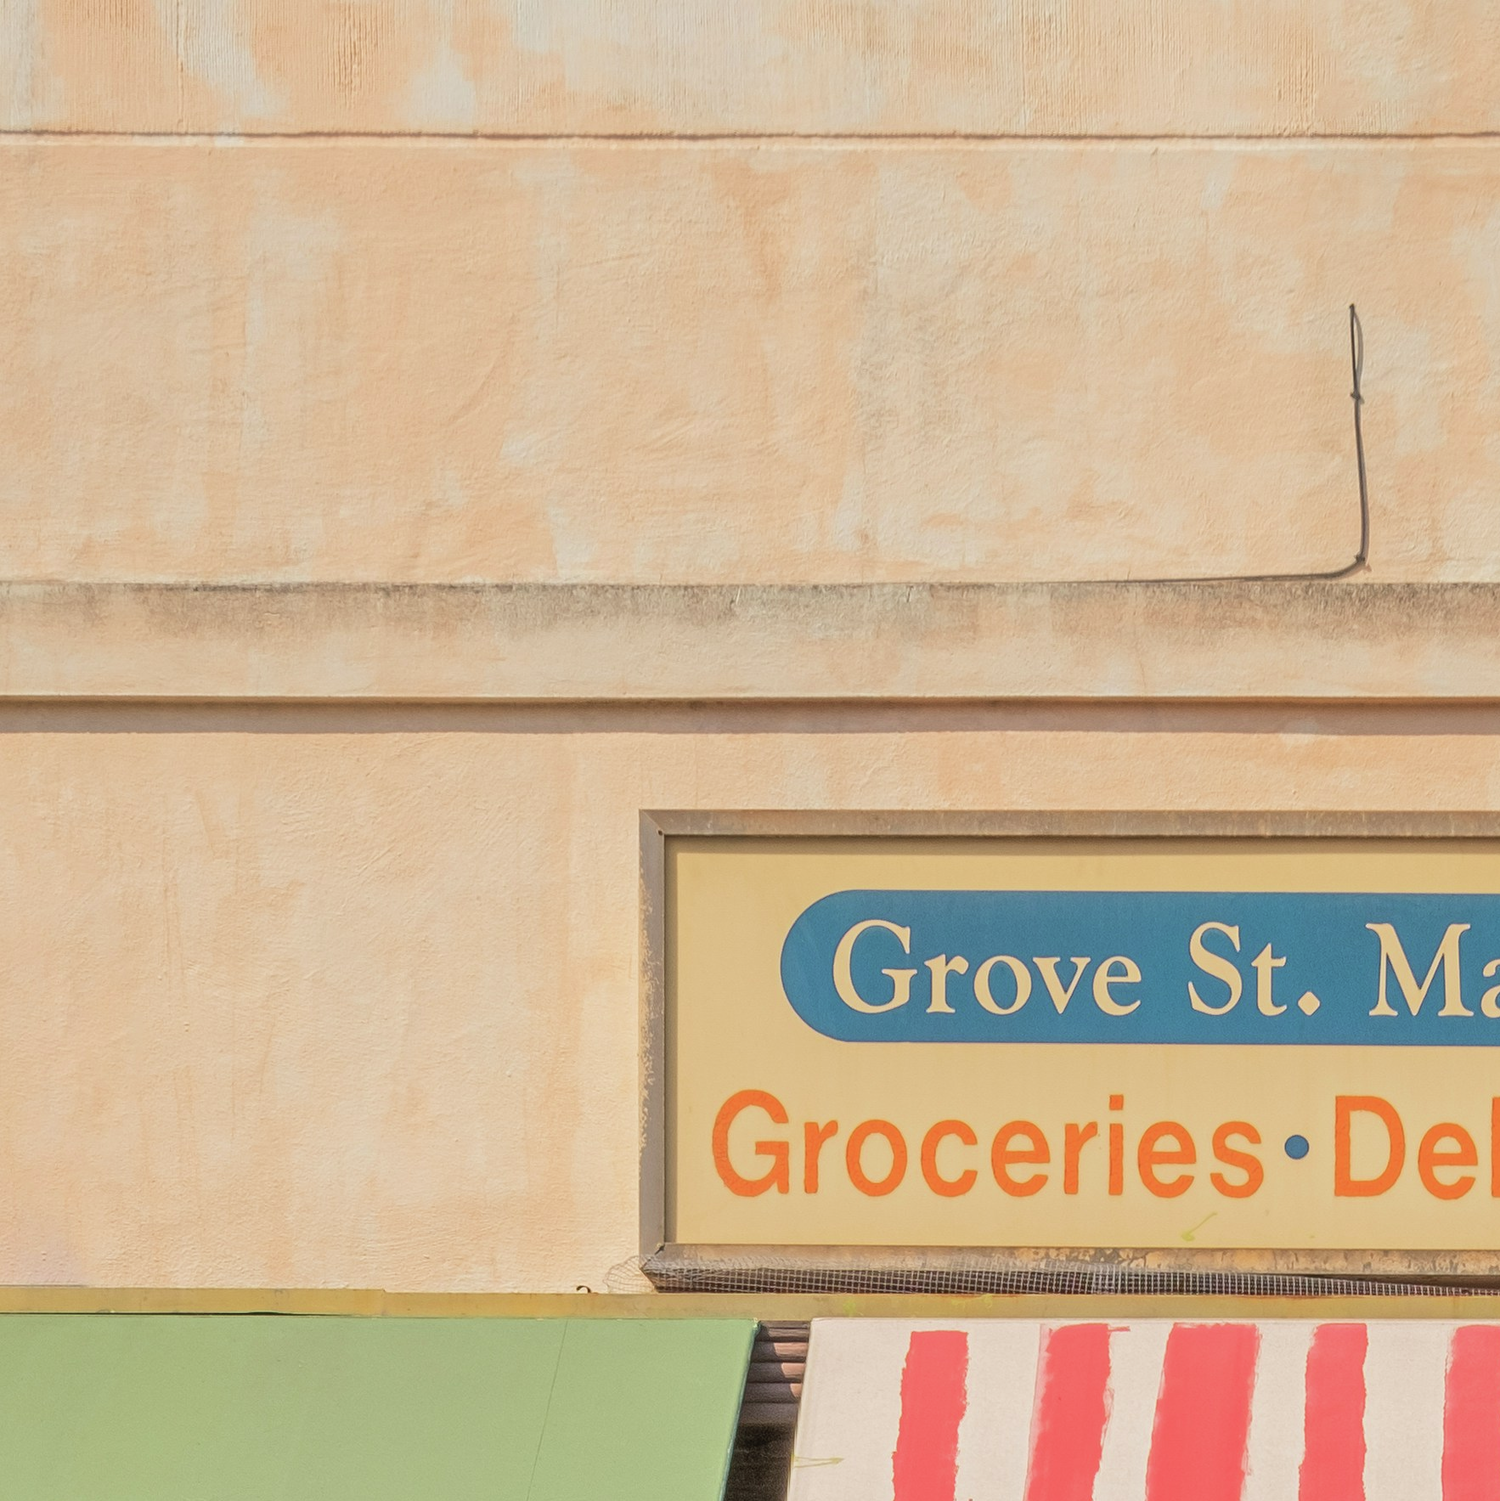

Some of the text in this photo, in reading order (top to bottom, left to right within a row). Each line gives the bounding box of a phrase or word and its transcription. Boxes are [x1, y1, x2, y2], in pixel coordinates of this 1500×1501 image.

[832, 918, 1142, 1015] Grove
[1187, 921, 1322, 1017] St.
[711, 1089, 1265, 1198] Groceries
